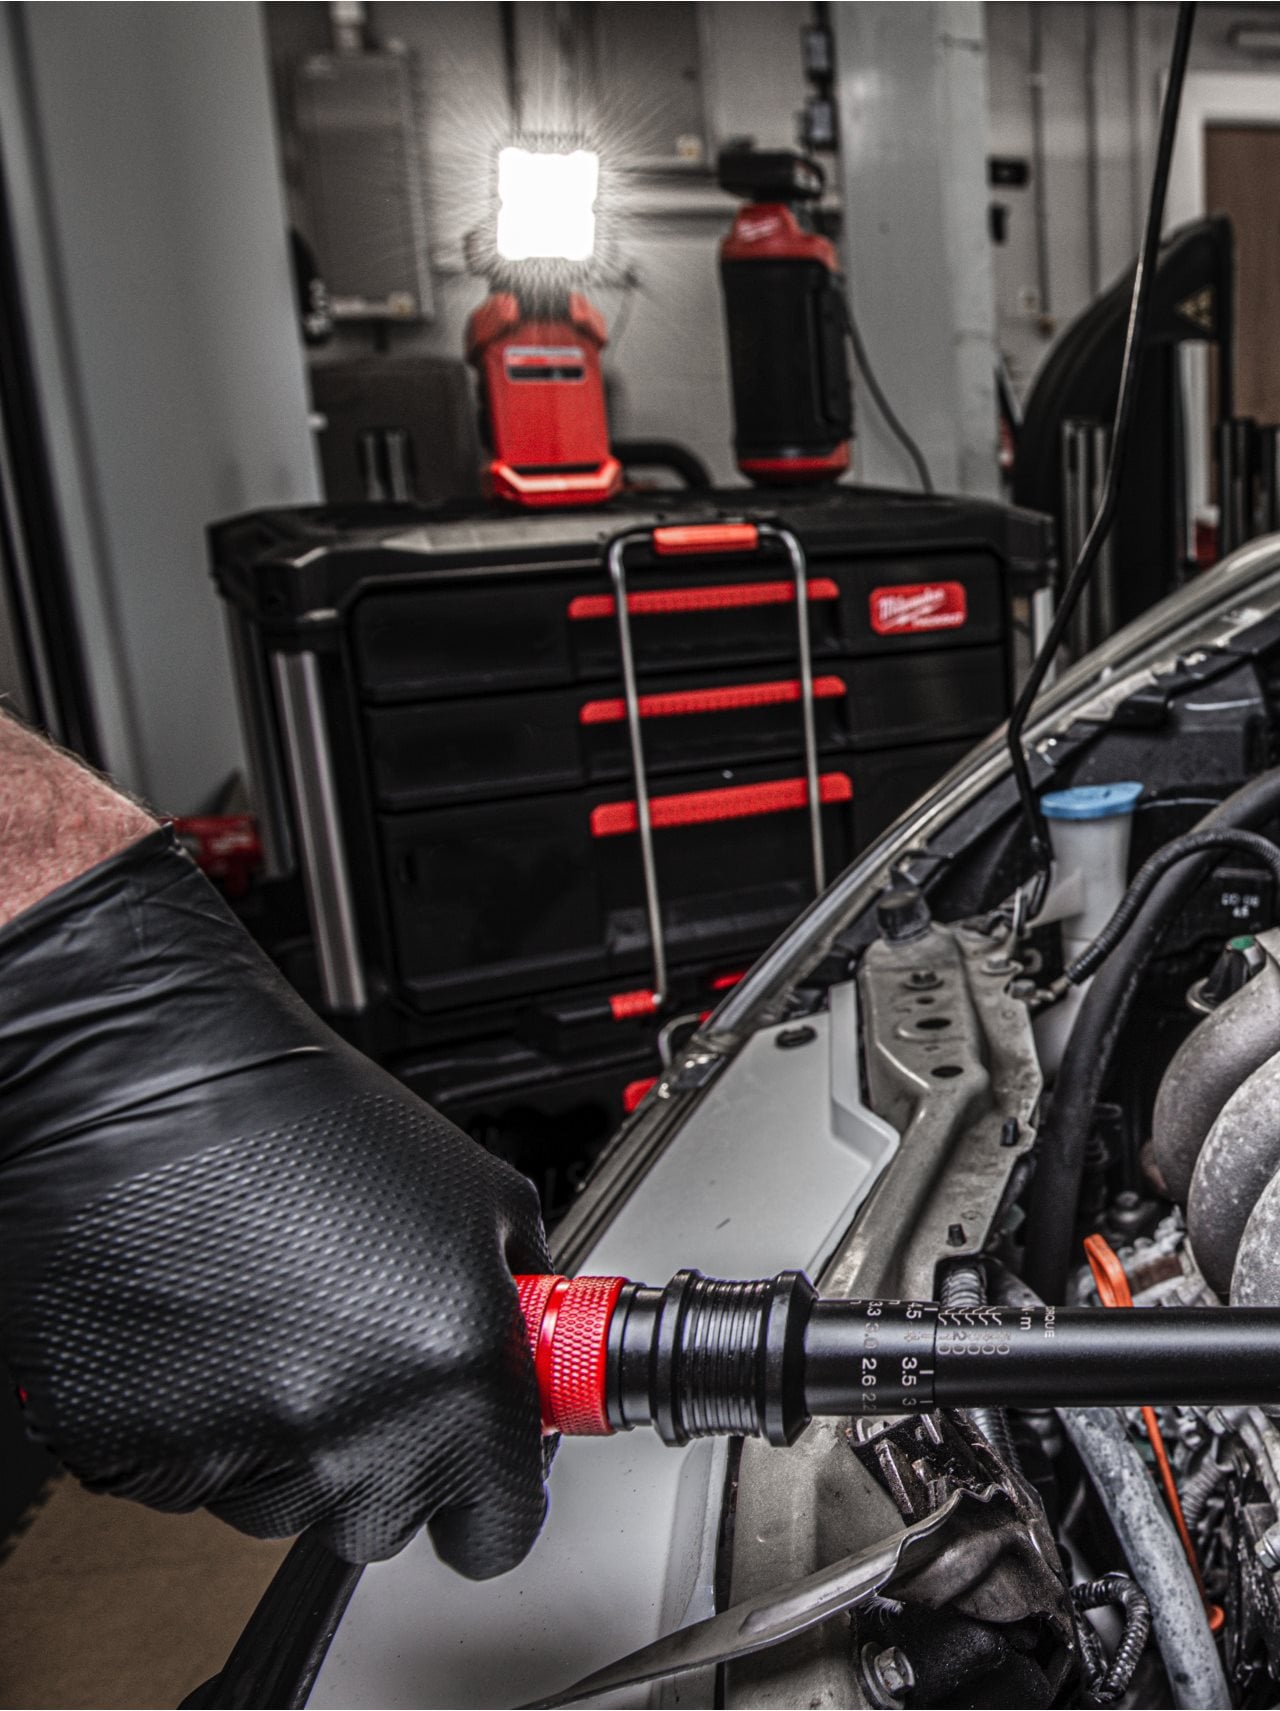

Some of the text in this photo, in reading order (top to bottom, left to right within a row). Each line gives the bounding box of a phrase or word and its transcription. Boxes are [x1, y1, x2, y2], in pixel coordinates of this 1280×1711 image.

[866, 1300, 883, 1317] 3.3
[863, 1321, 881, 1350] 3.0
[861, 1357, 878, 1387] 2.6
[901, 1357, 919, 1387] 3.5
[902, 1397, 918, 1407] 3
